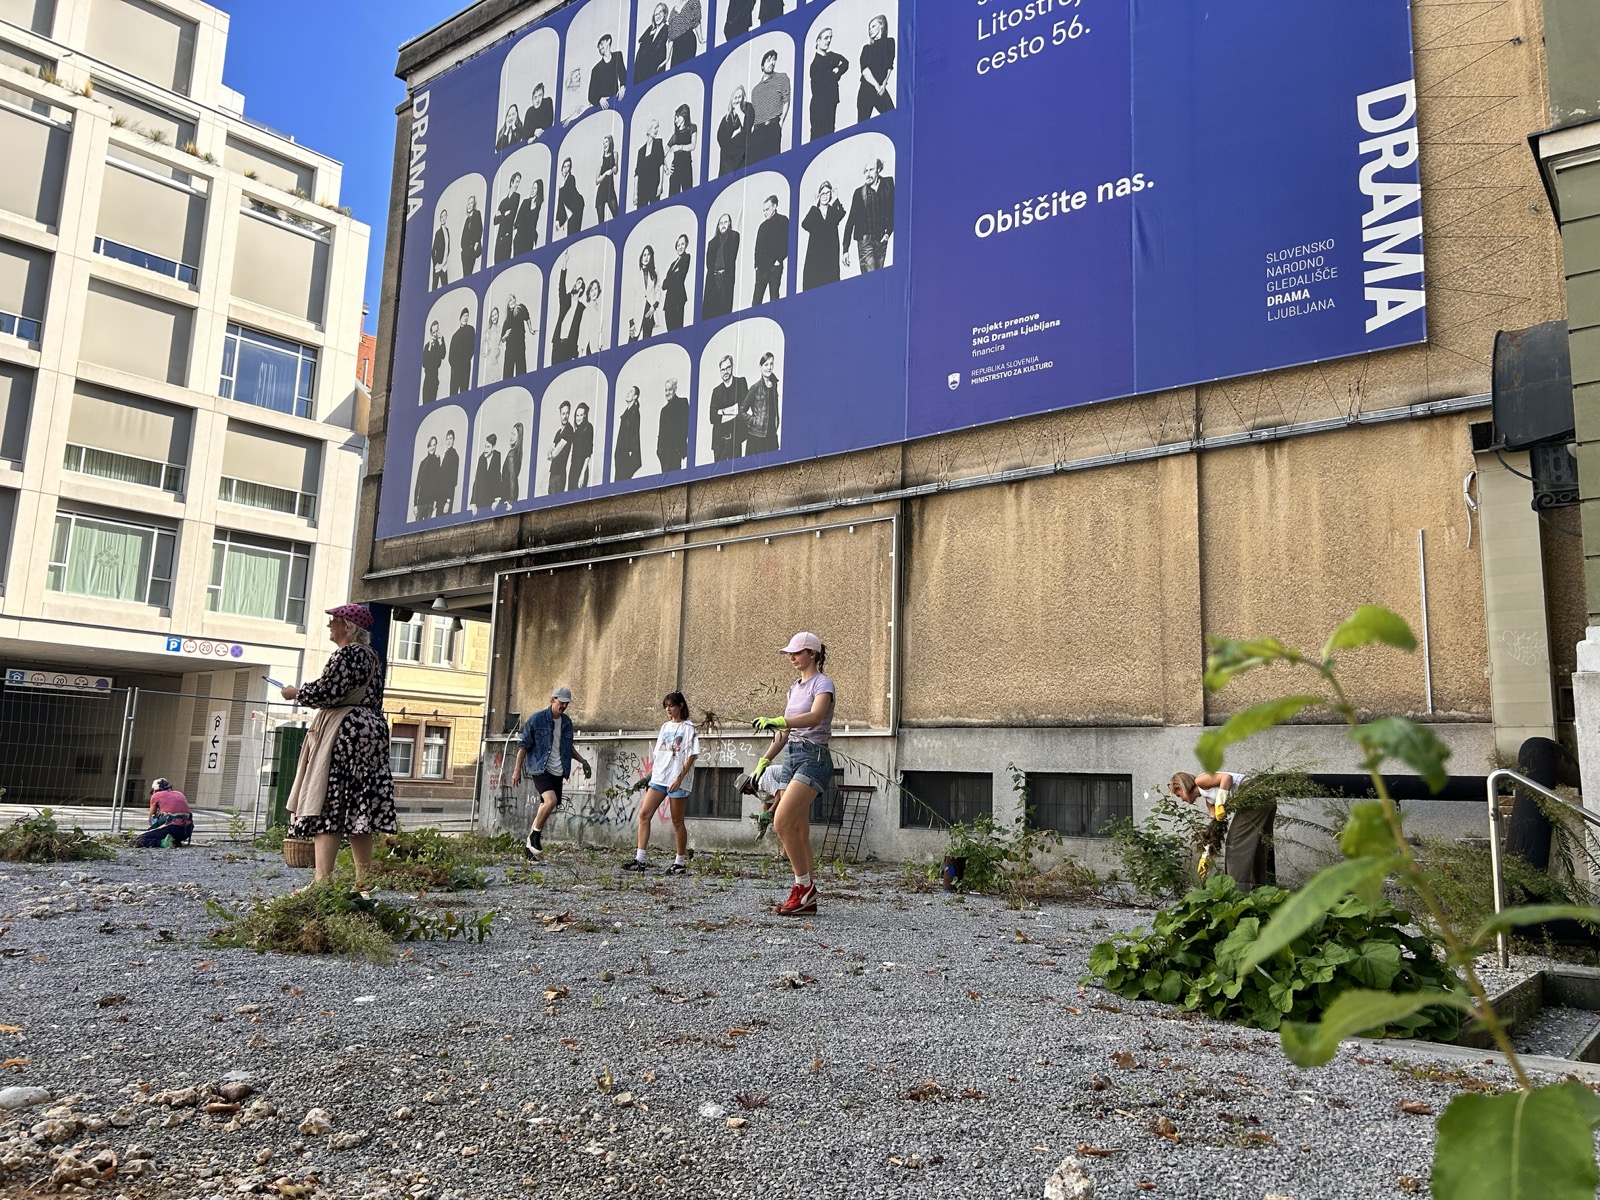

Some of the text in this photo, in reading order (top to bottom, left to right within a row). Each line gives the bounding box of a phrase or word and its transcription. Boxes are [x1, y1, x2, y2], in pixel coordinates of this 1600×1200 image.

[976, 14, 1091, 75] cesto 56.
[406, 90, 431, 222] DRAMA
[974, 172, 1155, 238] Obiščite nas.
[1356, 78, 1427, 334] DRAMA
[1265, 238, 1335, 264] SLOVENSKO
[1266, 255, 1324, 278] NARODNO
[1266, 266, 1338, 293] GLEDALIŠČE
[1266, 288, 1311, 307] DRAMA
[1267, 298, 1336, 321] LJUBLJANA
[972, 313, 1040, 336] Projekt prenove
[972, 319, 1061, 346] SNG Drama Ljubljana
[971, 344, 1005, 358] financira
[971, 355, 1039, 376] REPUBLIKA SLOVENIJA
[971, 360, 1054, 385] MINISTRSTVO ZA KULTURO
[169, 640, 178, 650] P
[201, 644, 210, 652] 20
